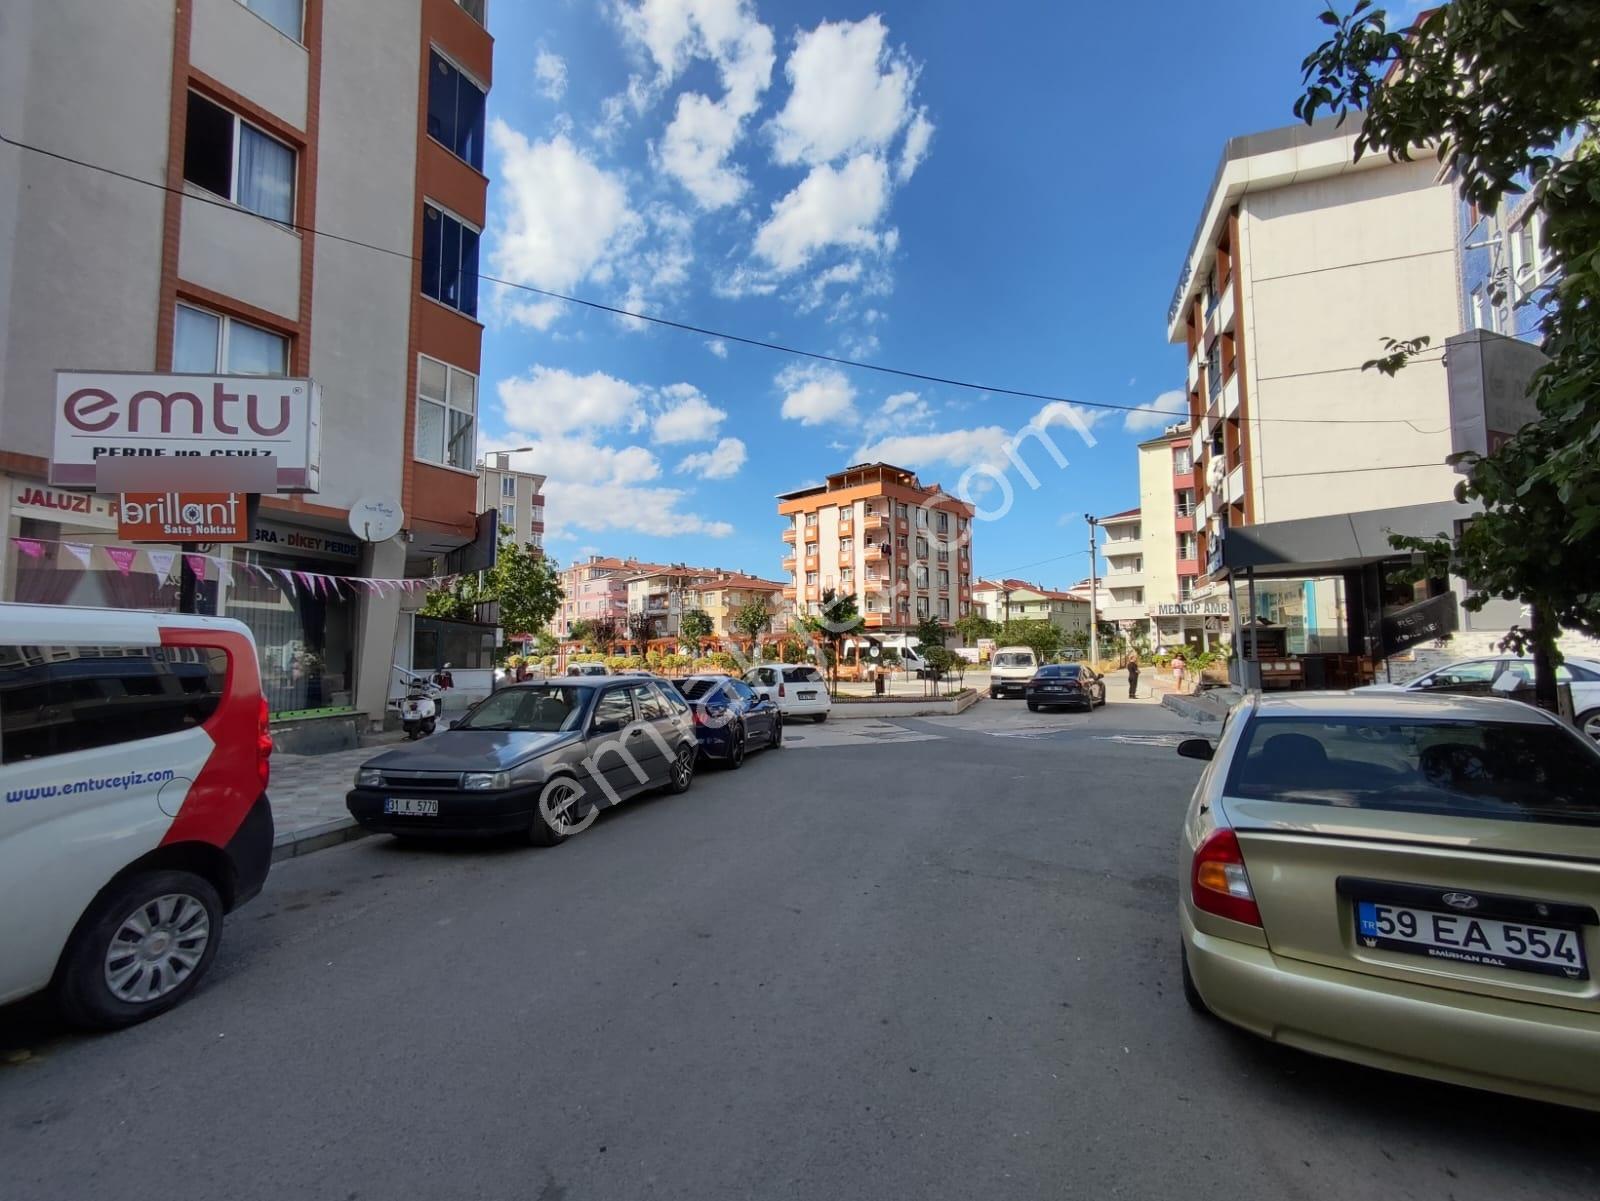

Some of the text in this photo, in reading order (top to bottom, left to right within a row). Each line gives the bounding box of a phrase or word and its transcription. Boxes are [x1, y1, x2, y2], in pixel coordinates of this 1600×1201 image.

[64, 382, 290, 437] emtu
[17, 487, 91, 513] JALUZİ
[120, 492, 239, 525] brillant
[164, 524, 236, 536] Satış Noktası
[6, 769, 175, 803] www.emtuceyiz.com
[1362, 906, 1576, 964] TR 59 EA 554
